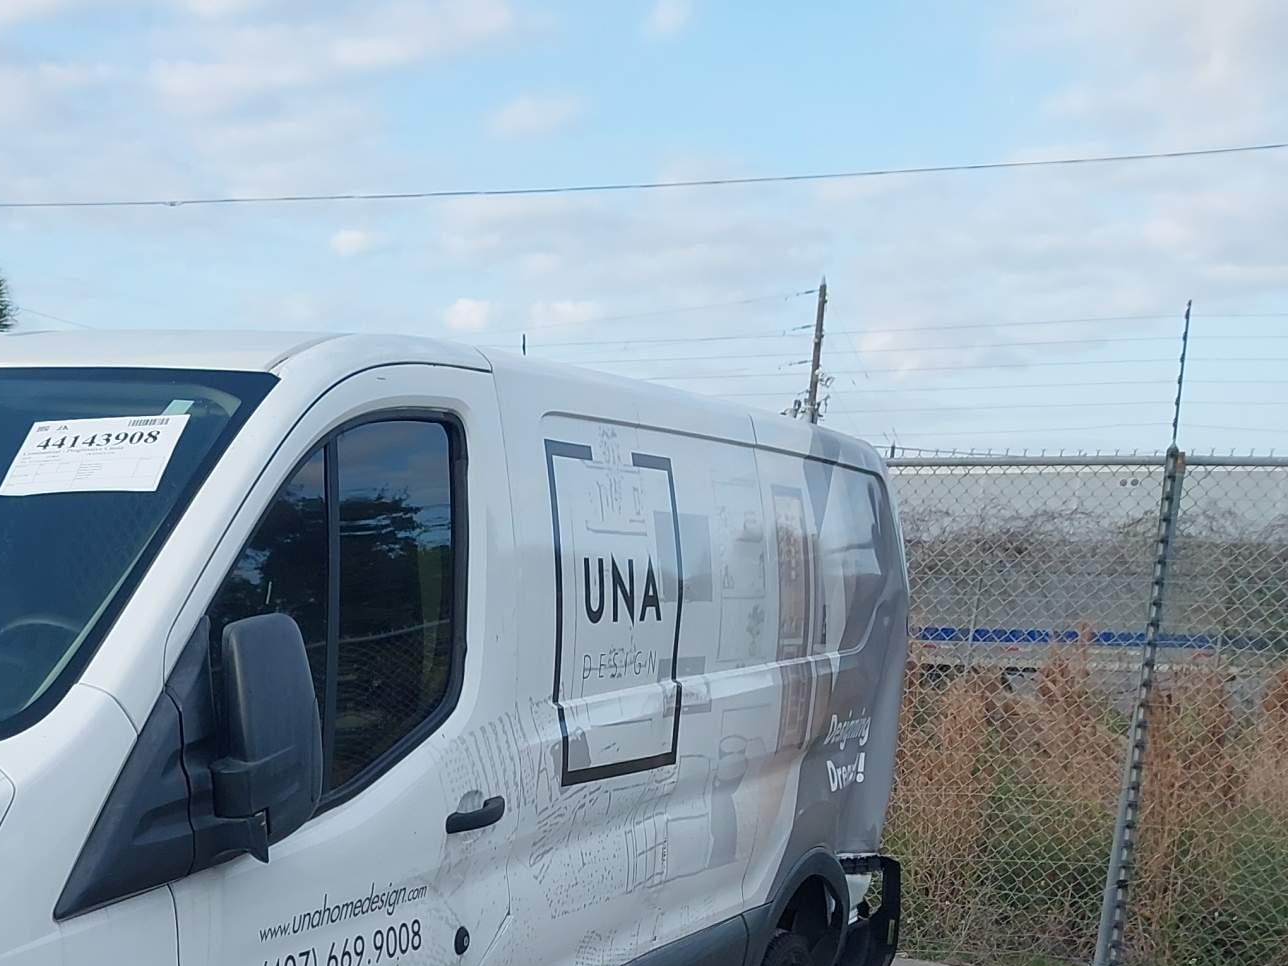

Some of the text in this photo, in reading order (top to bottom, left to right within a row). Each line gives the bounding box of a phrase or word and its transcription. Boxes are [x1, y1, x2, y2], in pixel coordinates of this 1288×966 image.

[36, 430, 161, 450] 44143908
[583, 552, 662, 627] UNA
[582, 649, 657, 680] DESIGN
[259, 882, 428, 942] www.unahomedesign.com
